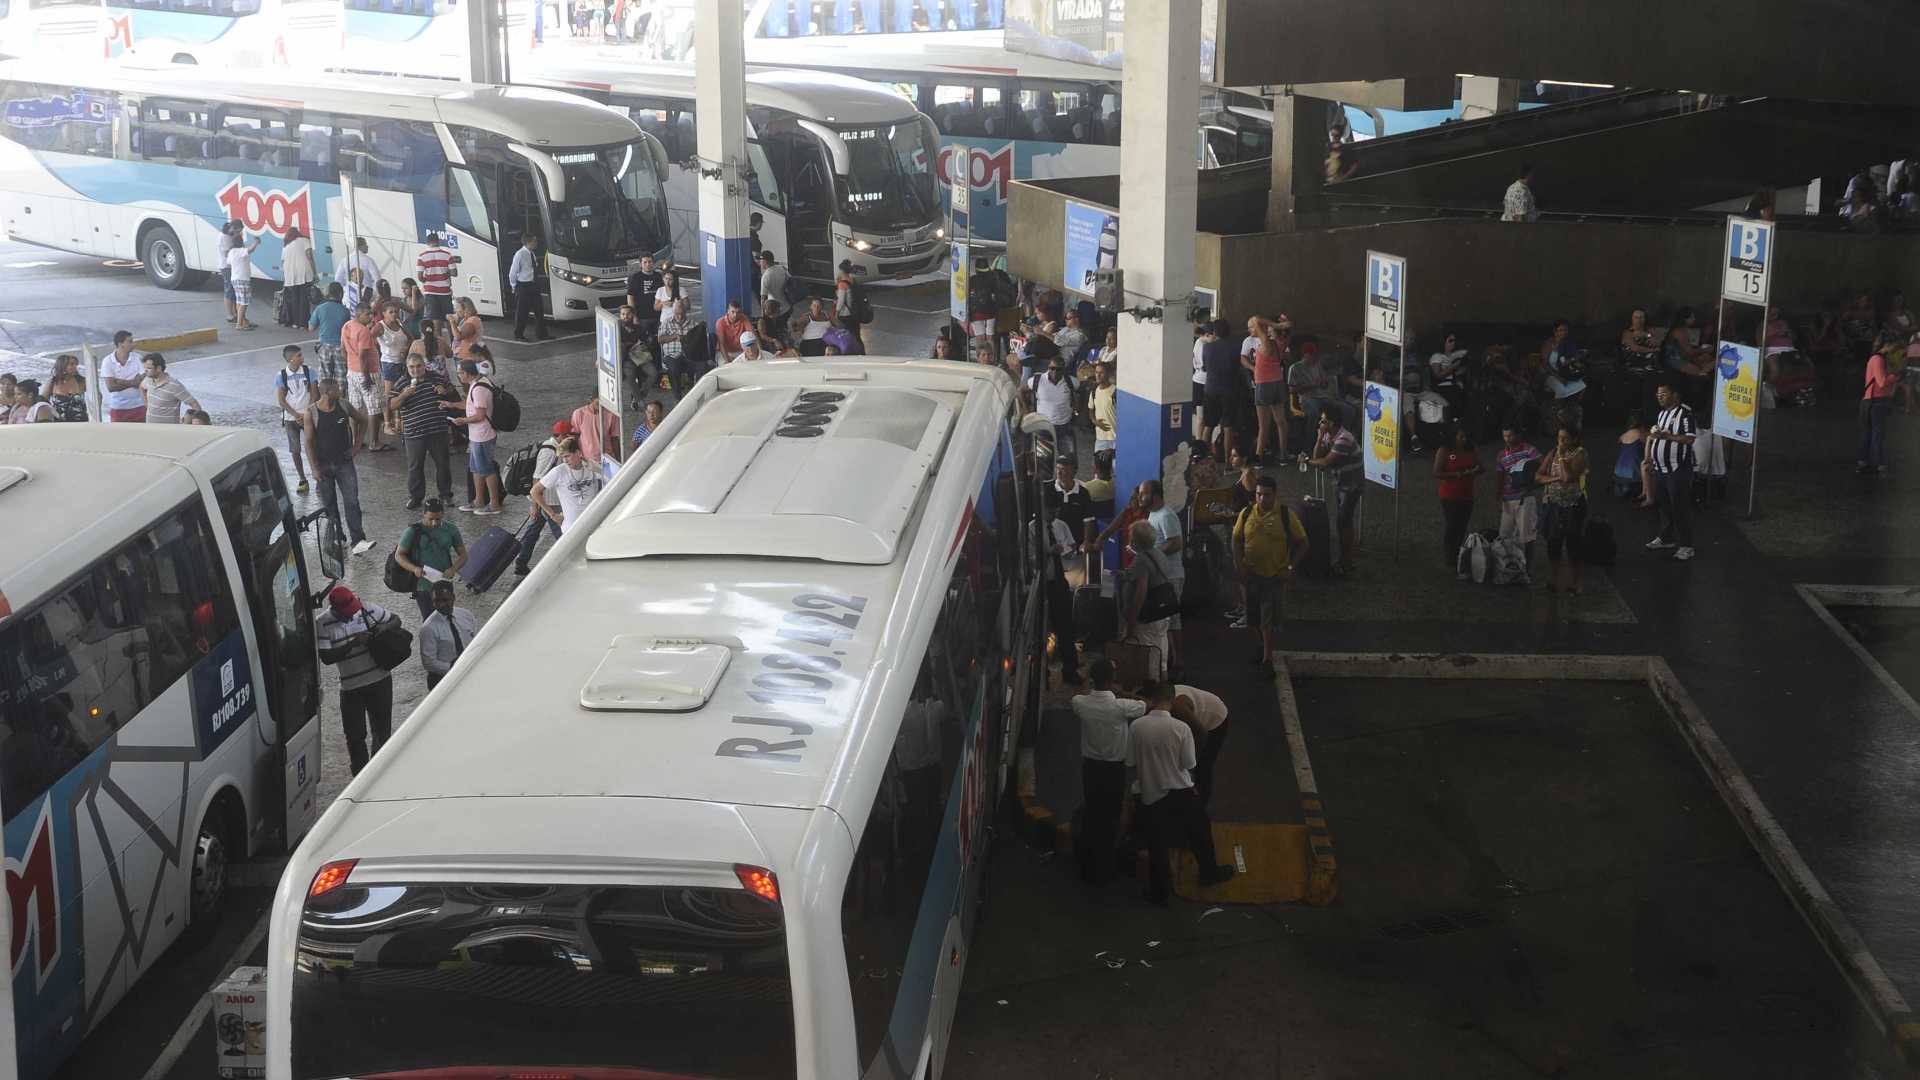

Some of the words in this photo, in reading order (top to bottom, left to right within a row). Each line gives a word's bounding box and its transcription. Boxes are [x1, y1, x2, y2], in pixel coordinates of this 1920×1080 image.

[218, 180, 311, 240] 1001
[1741, 224, 1759, 260] B
[1379, 263, 1393, 298] B
[1743, 273, 1760, 294] 15
[1382, 311, 1396, 333] 14
[602, 321, 611, 362] B
[606, 377, 615, 402] 13
[1728, 392, 1740, 401] POR
[226, 995, 256, 1005] ARNO
